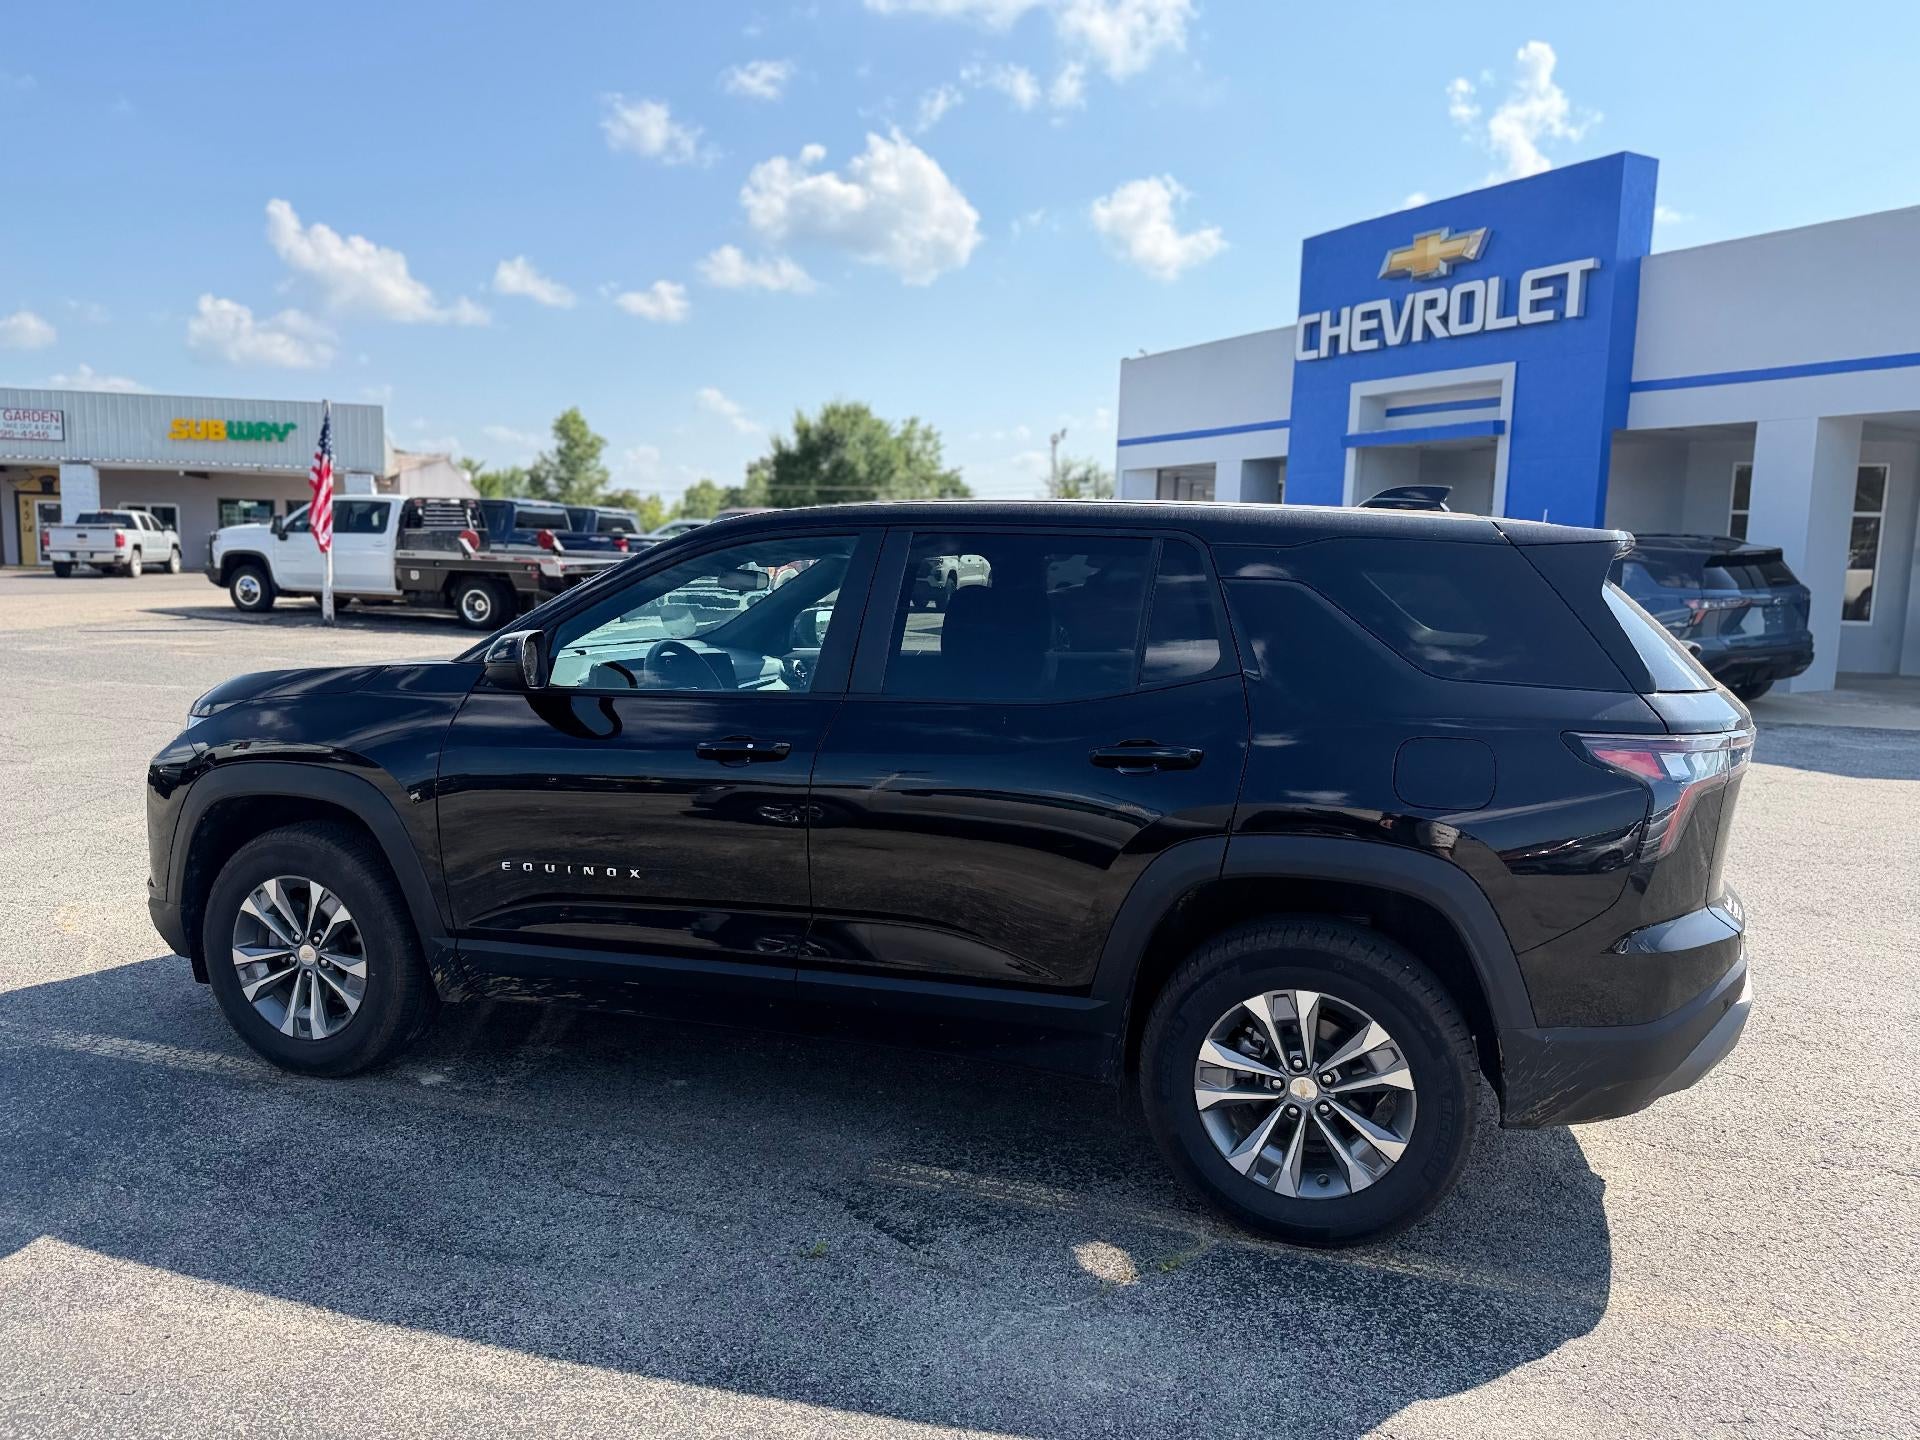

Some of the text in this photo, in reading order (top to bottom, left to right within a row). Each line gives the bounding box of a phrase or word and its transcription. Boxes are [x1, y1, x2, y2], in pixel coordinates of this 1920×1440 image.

[1295, 257, 1599, 361] CHEVROLET
[3, 410, 60, 423] GARDEN
[167, 418, 298, 442] SUBWAY
[501, 861, 640, 878] EQUINOX
